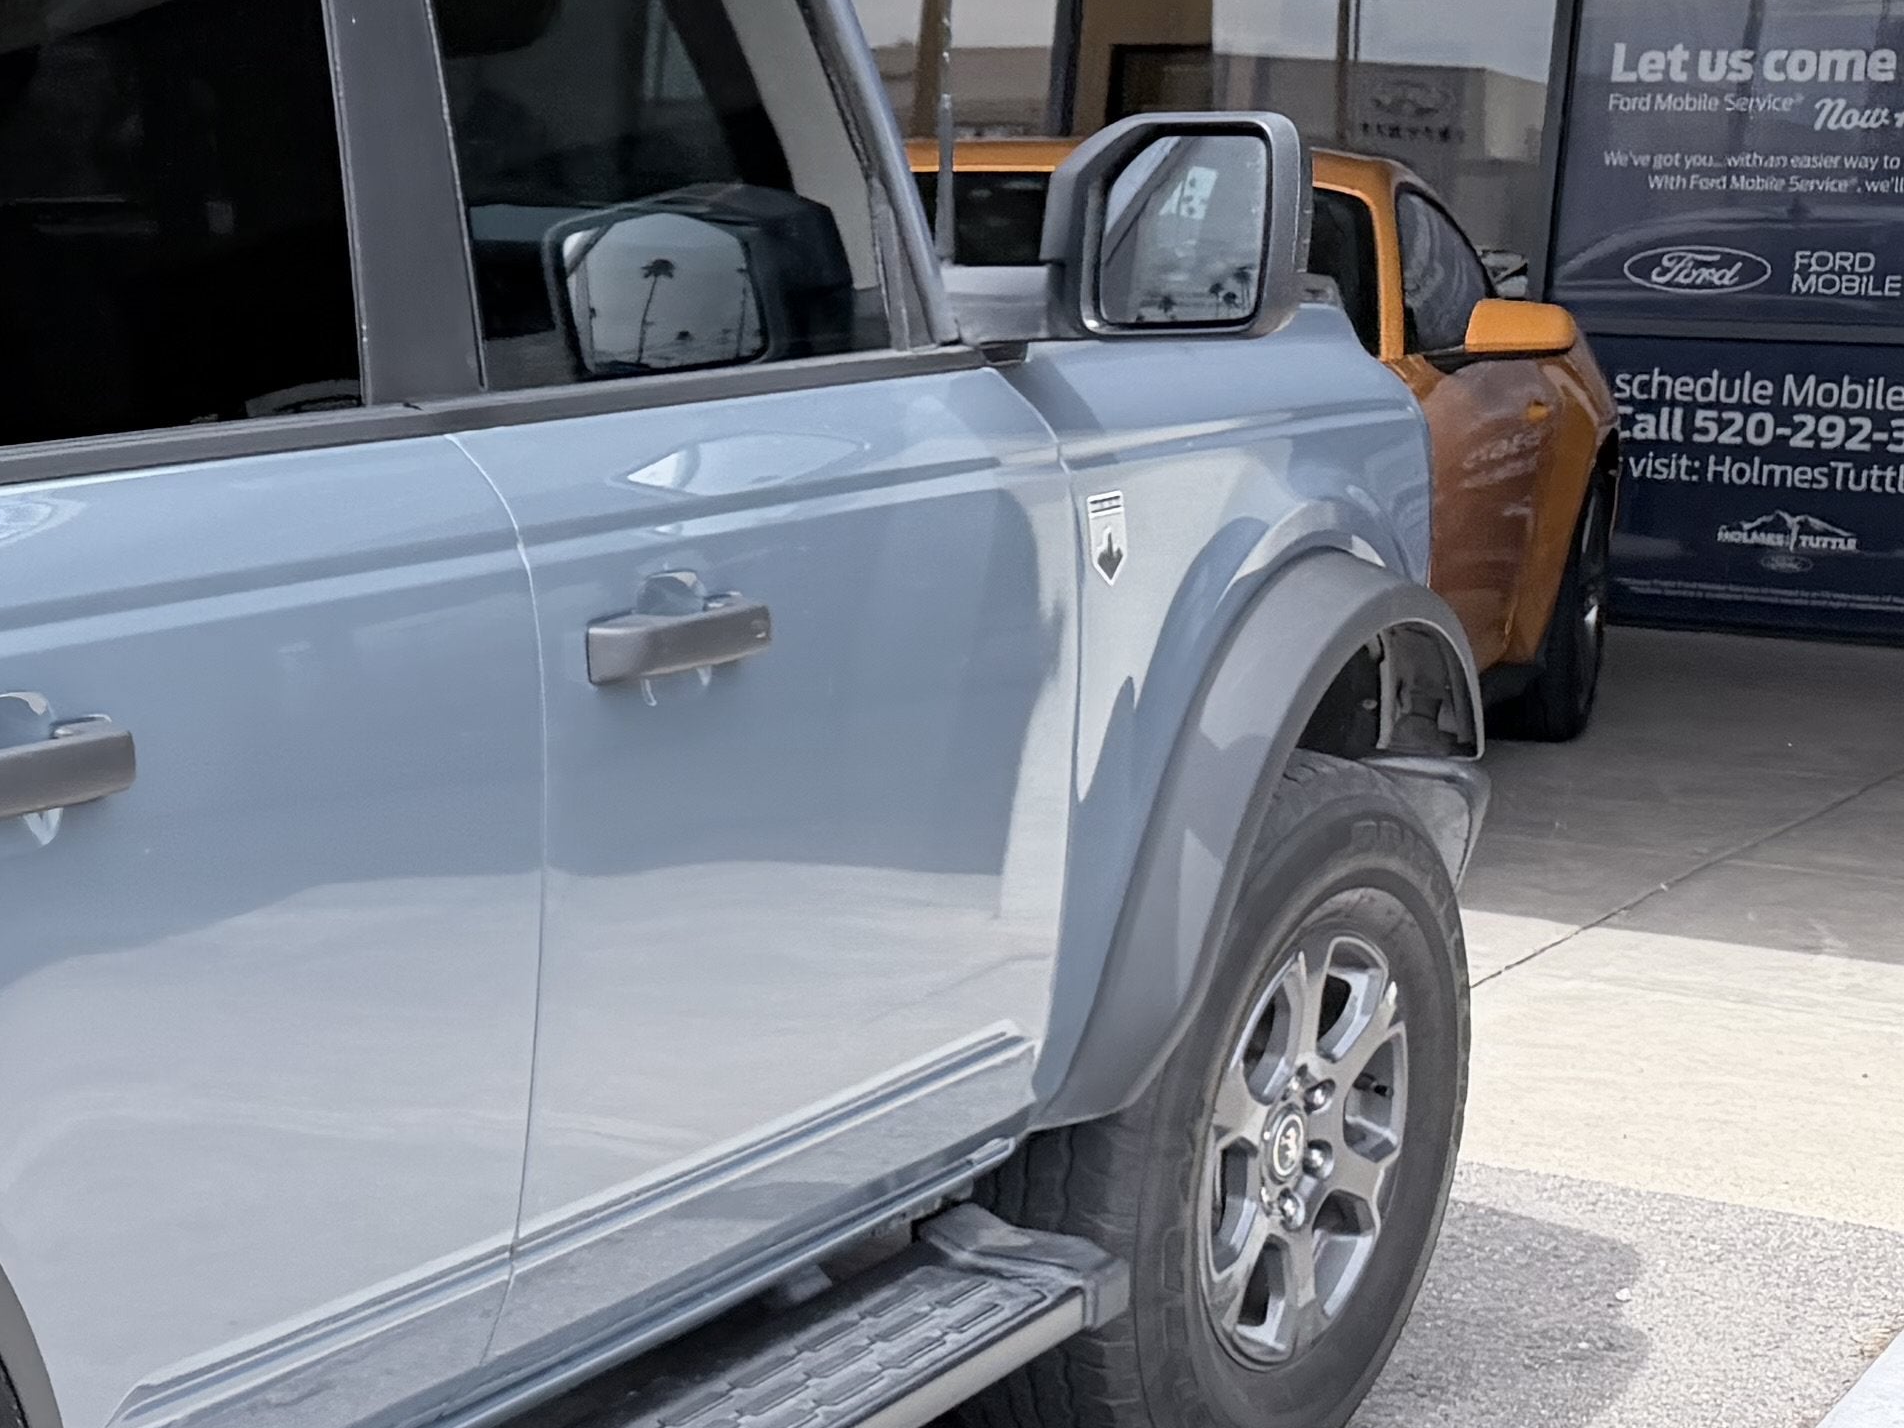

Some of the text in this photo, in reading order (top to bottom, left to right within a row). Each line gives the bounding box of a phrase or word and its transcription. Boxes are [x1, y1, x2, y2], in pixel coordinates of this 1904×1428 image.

[1611, 43, 1897, 83] Let us come
[1608, 92, 1651, 112] Ford
[1654, 92, 1719, 112] Mobile
[1814, 98, 1890, 131] Now
[1604, 150, 1650, 167] We've
[1653, 153, 1681, 170] got
[1790, 155, 1842, 169] easier
[1844, 156, 1880, 171] way
[1883, 156, 1901, 170] to
[1648, 174, 1687, 191] With
[1689, 174, 1728, 191] Ford
[1651, 251, 1743, 286] Ford
[1793, 250, 1876, 273] FORD
[1791, 274, 1903, 297] MOBILE
[1613, 367, 1904, 411] schedule Mobile
[1628, 451, 1701, 482] visit:
[1798, 534, 1859, 552] TUTTLE
